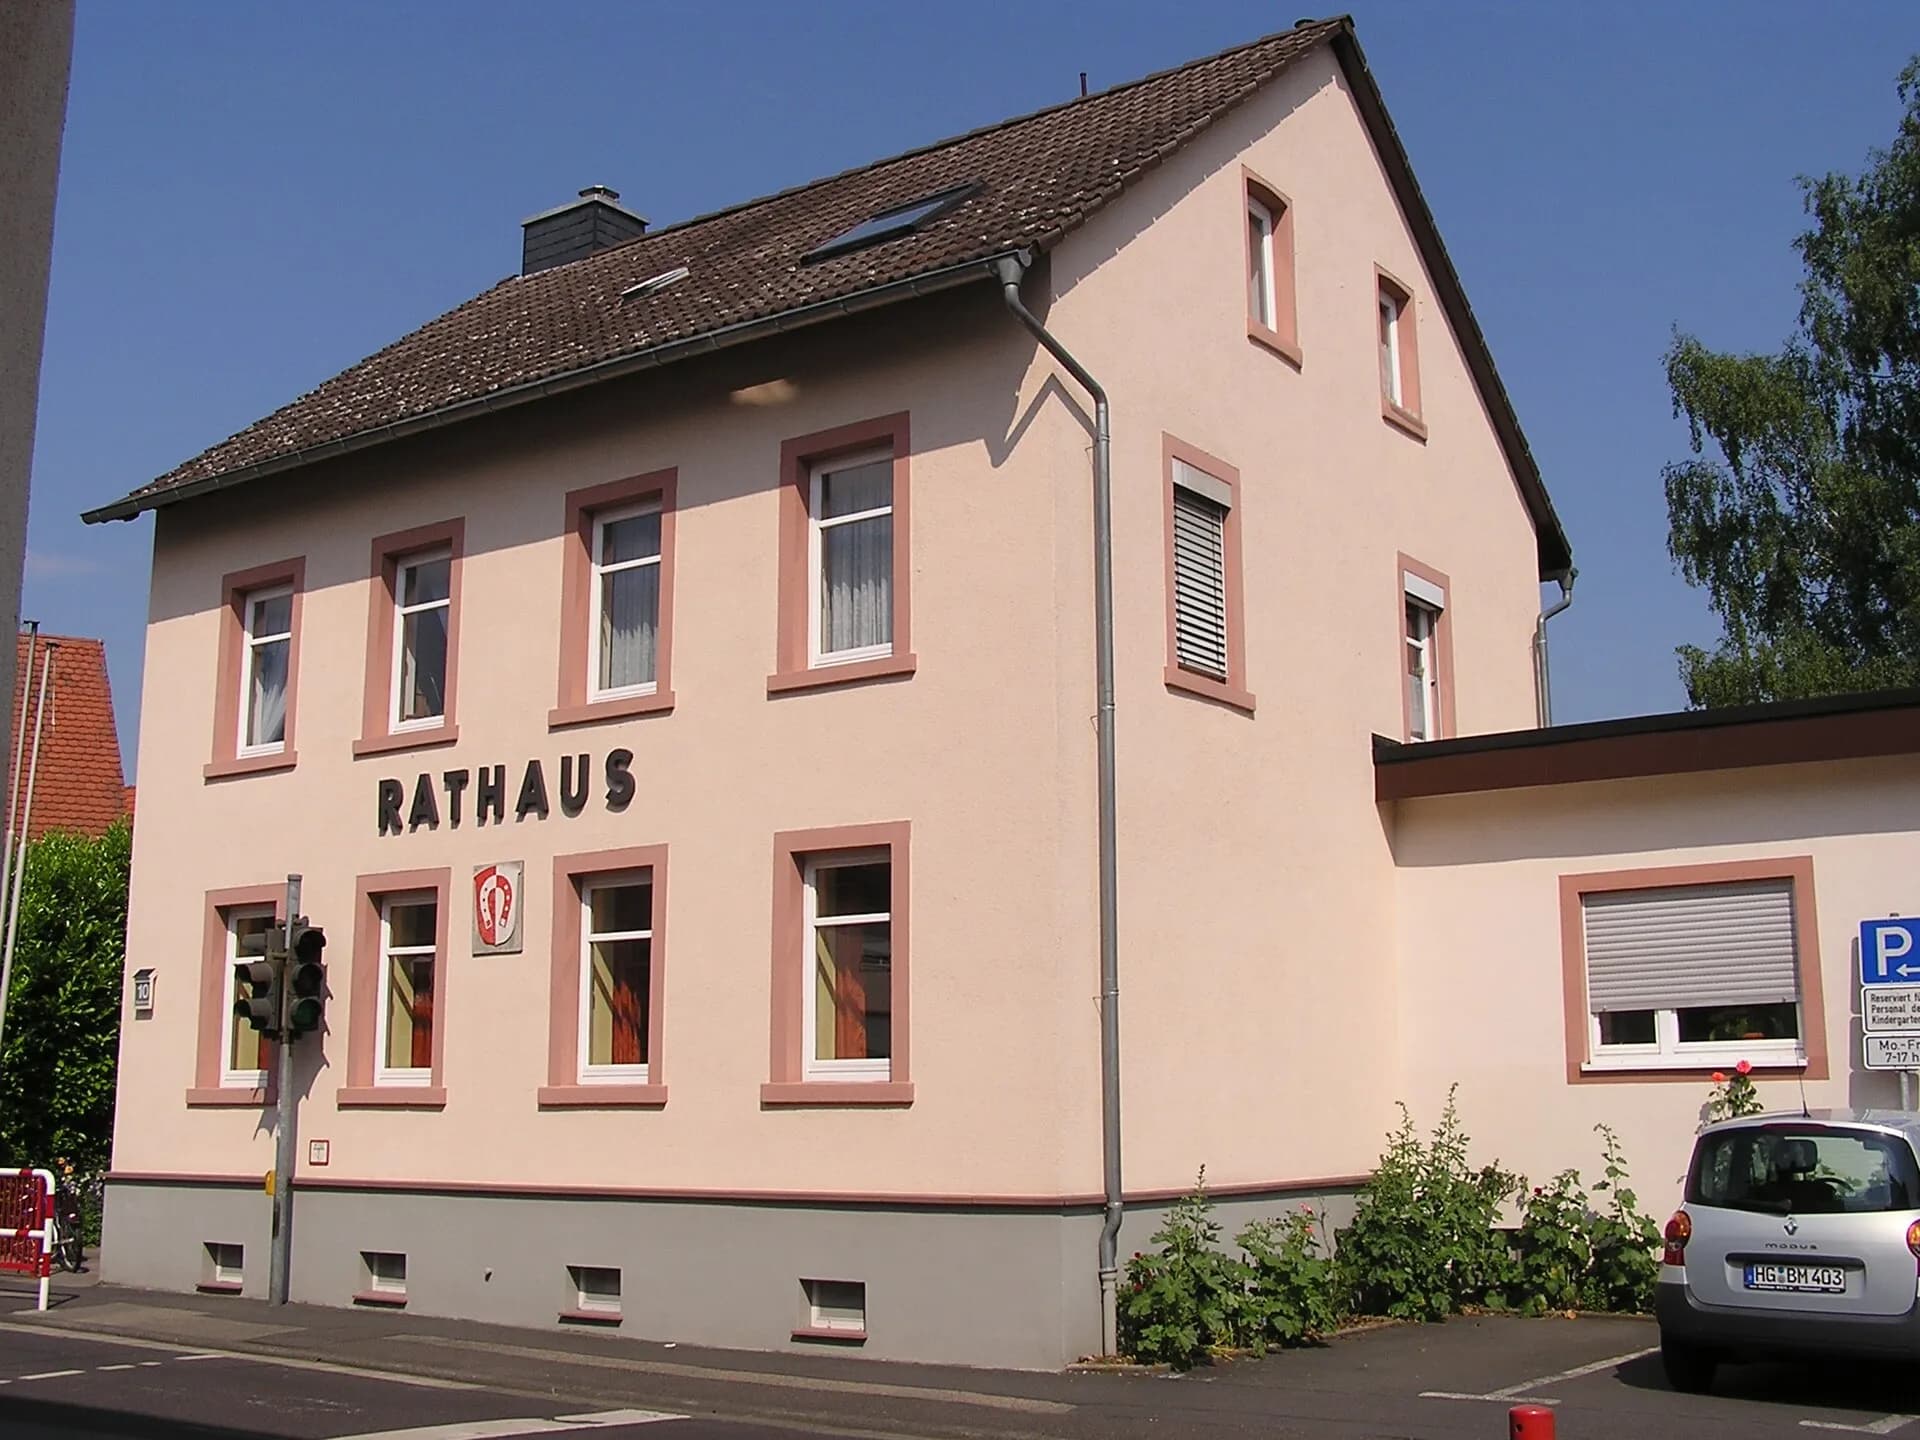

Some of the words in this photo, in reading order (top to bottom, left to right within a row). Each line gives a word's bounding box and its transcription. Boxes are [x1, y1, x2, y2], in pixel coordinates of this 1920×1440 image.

[378, 748, 635, 832] RATHAUS
[1876, 926, 1913, 976] P
[137, 984, 149, 999] 10
[1870, 993, 1911, 1003] Reserviert
[1871, 1004, 1906, 1014] Personal
[1885, 1052, 1908, 1063] 7-17
[1755, 1266, 1776, 1283] HG
[1811, 1269, 1842, 1286] 403
